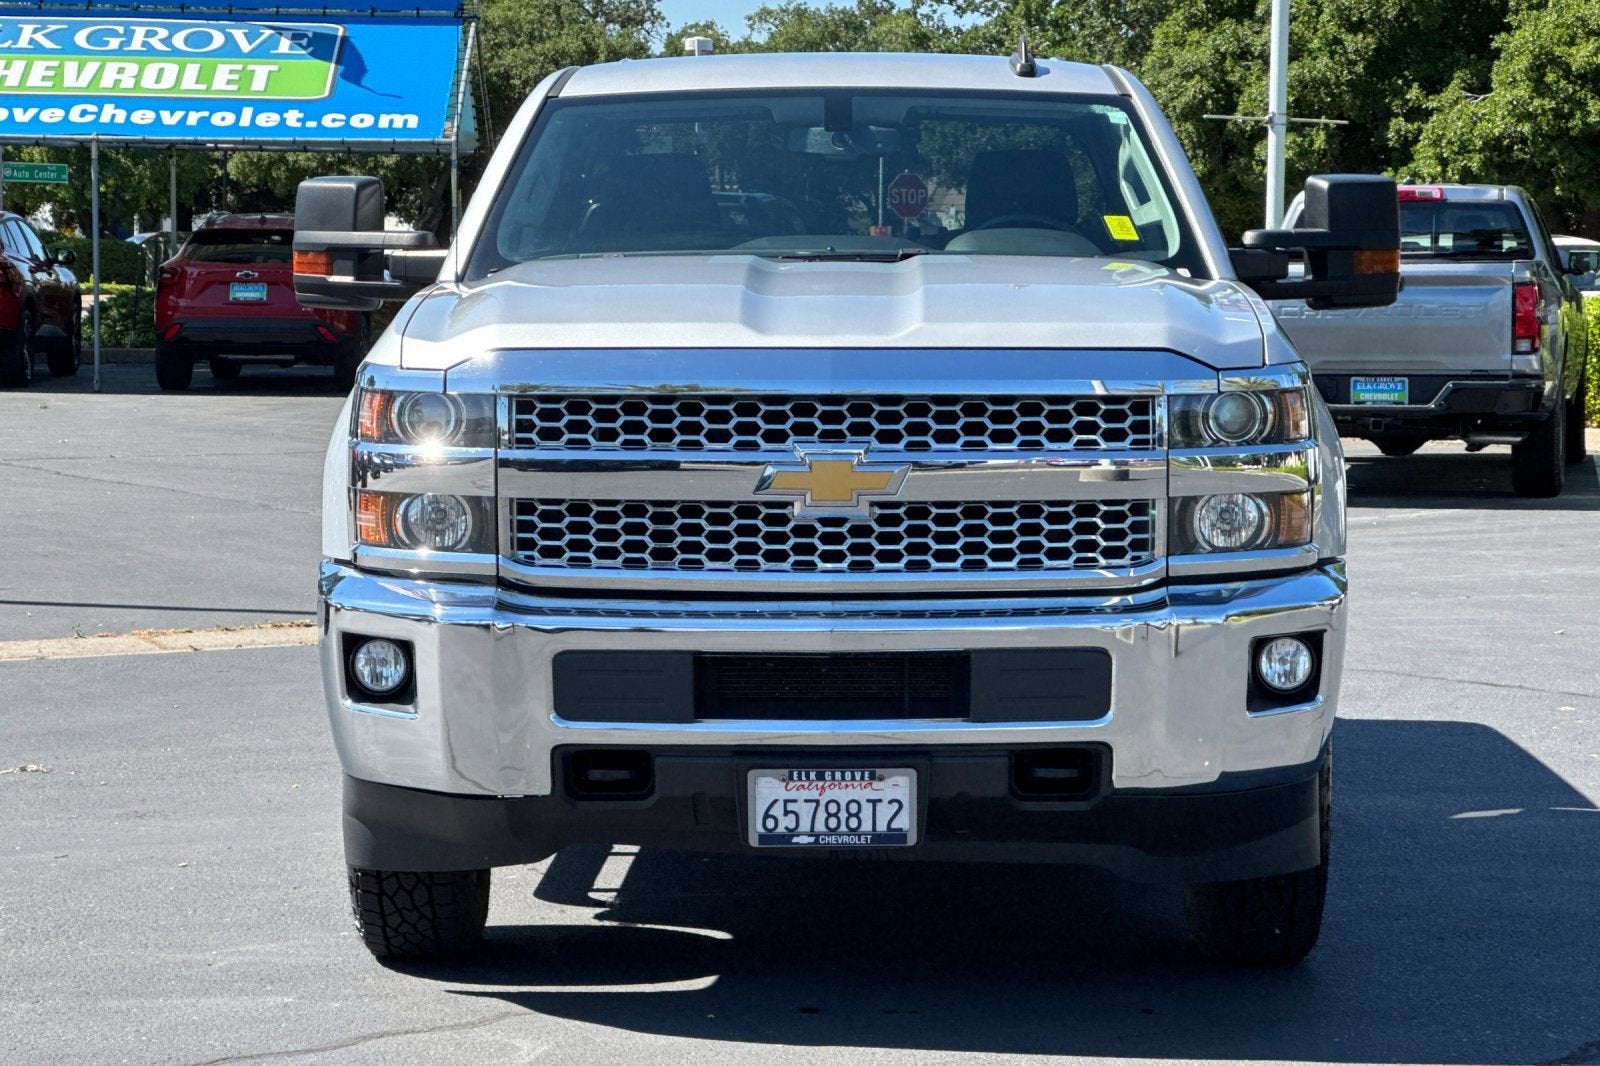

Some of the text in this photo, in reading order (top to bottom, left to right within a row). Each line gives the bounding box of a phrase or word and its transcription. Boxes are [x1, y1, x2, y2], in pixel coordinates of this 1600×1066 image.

[74, 25, 314, 54] GROVE
[13, 169, 30, 178] Auto
[34, 169, 58, 179] Center
[891, 188, 926, 205] STOP
[793, 771, 871, 781] ELK GROVE
[784, 781, 884, 797] California
[761, 798, 904, 833] 65788T2
[819, 835, 872, 844] CHEVROLET
